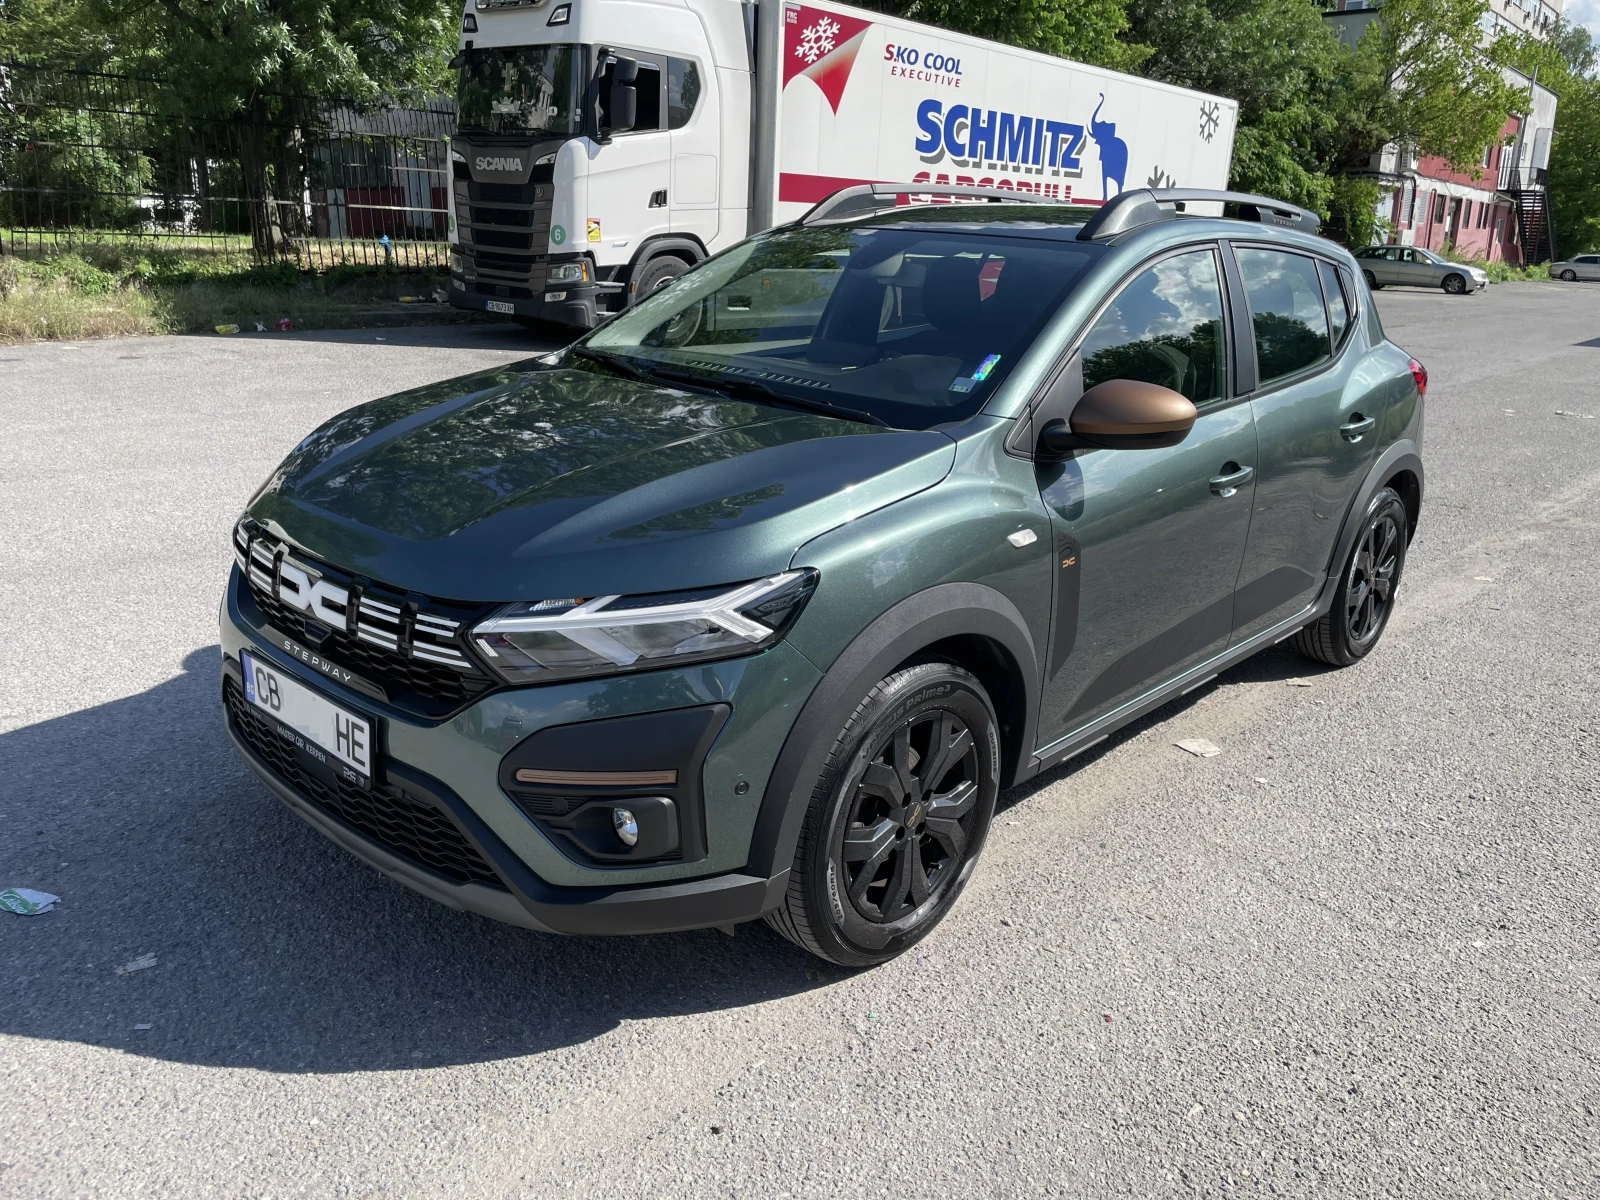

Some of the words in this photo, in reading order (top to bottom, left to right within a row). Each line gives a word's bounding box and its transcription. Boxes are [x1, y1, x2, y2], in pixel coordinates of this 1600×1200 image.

[883, 43, 919, 66] S.KO
[923, 52, 963, 76] COOL
[891, 65, 962, 88] EXECUTIVE
[914, 98, 1086, 174] SCHMITZ
[475, 156, 523, 172] SCANIA
[554, 229, 562, 241] 6
[283, 640, 352, 682] STEPWAY
[246, 681, 255, 696] BG
[255, 666, 281, 712] CB
[335, 712, 367, 768] HE
[277, 725, 296, 743] MASTER
[295, 737, 305, 750] CAR
[305, 744, 326, 764] KERPEN
[989, 732, 997, 772] OUTSIDE
